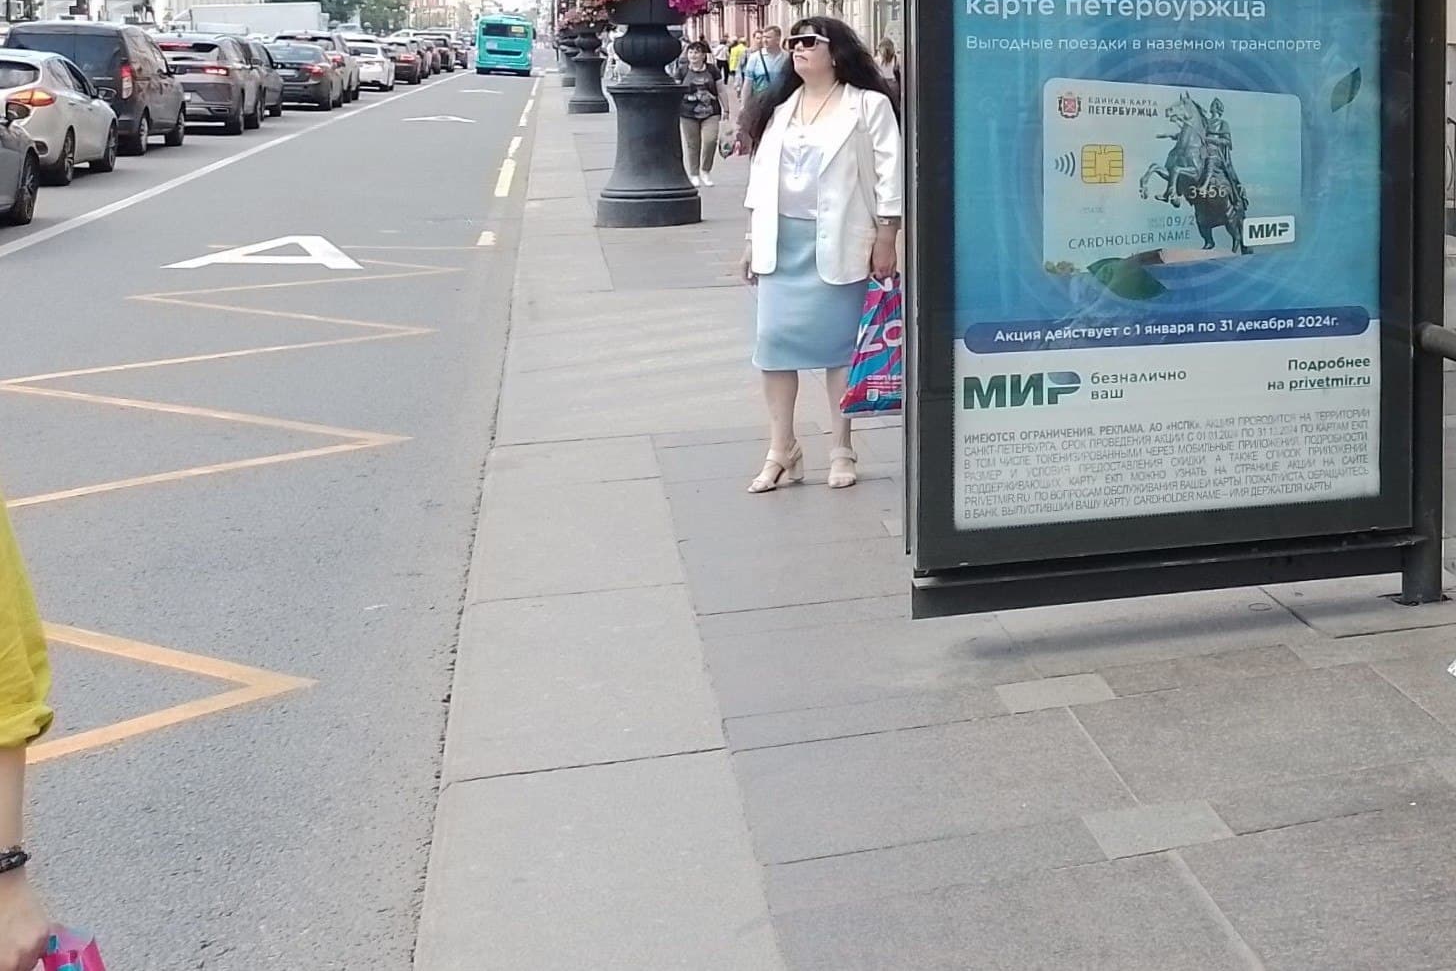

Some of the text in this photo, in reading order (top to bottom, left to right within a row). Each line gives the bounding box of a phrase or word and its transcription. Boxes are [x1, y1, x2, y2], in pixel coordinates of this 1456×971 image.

[966, 35, 1321, 52] Выгодные поездки в наземном транспорте
[1088, 96, 1158, 106] ЕДИНАЯ КАРТА
[1088, 105, 1158, 117] ПЕТЕРБУРЖЦА
[1248, 222, 1290, 240] МИР
[1068, 230, 1191, 250] CARDHOLDER NAME
[994, 315, 1339, 342] Акция действует с 1 января по 31 декабря 2024г.
[1288, 356, 1371, 372] Подробнее
[1090, 370, 1187, 385] безналично
[1267, 375, 1371, 391] на privetmir.ru
[963, 371, 1081, 410] МИР
[1091, 388, 1124, 400] ваш
[964, 432, 1015, 444] ИМЕЮТСЯ
[1150, 422, 1162, 431] АО
[1300, 412, 1311, 421] НА
[1090, 435, 1151, 448] ПРОВЕДЕНИЯ
[1323, 457, 1335, 467] НА
[1134, 493, 1194, 506] CARDHOLDER
